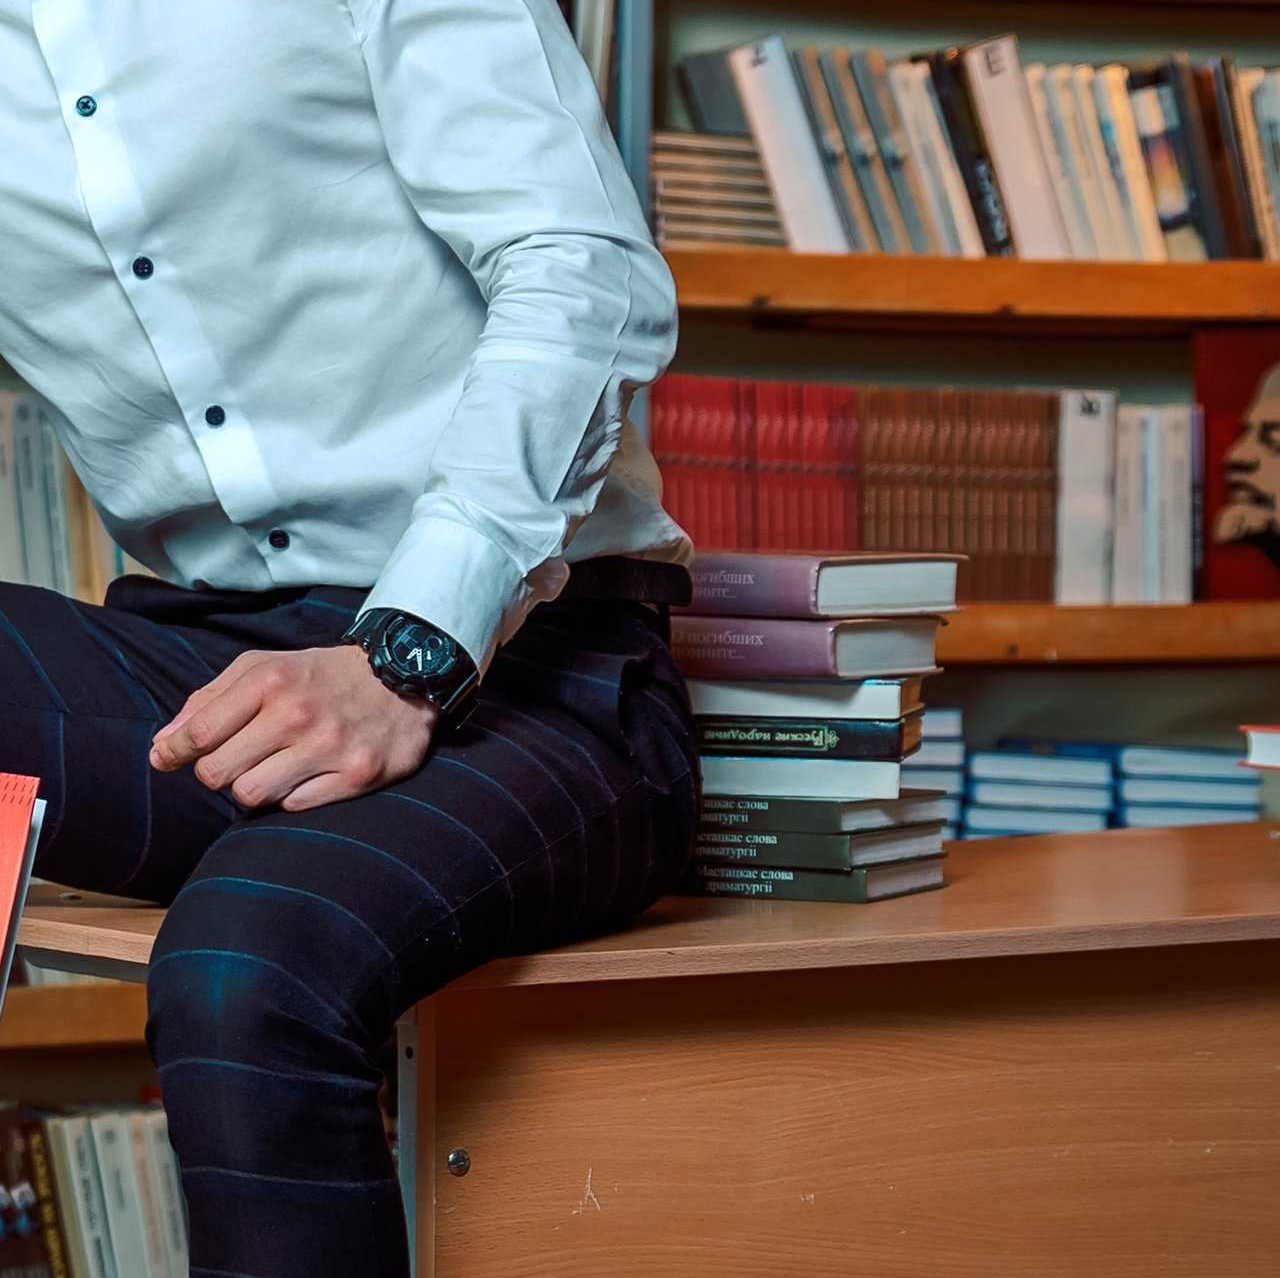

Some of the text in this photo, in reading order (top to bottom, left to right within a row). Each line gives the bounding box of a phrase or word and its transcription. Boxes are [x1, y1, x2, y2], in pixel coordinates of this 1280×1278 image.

[703, 799, 769, 810] ацкае слова
[745, 834, 778, 844] слова
[760, 869, 794, 881] слова
